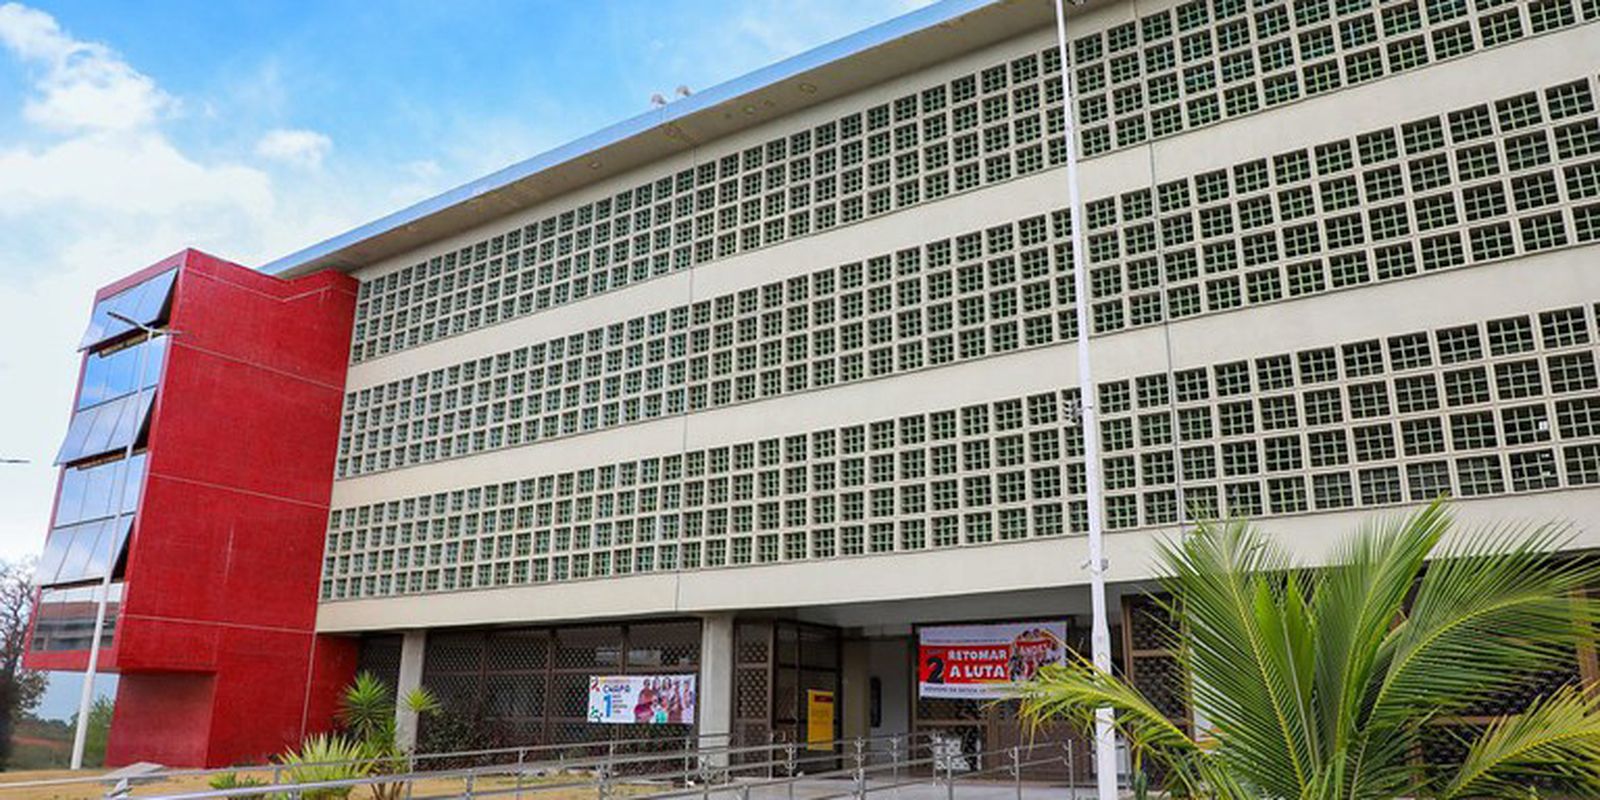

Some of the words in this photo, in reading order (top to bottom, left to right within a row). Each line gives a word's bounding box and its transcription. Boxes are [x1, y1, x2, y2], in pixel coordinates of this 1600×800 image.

[947, 649, 1007, 660] RETOMAR
[926, 657, 945, 684] 2
[949, 665, 961, 678] A
[964, 664, 1005, 678] LUTA
[603, 694, 611, 717] 1
